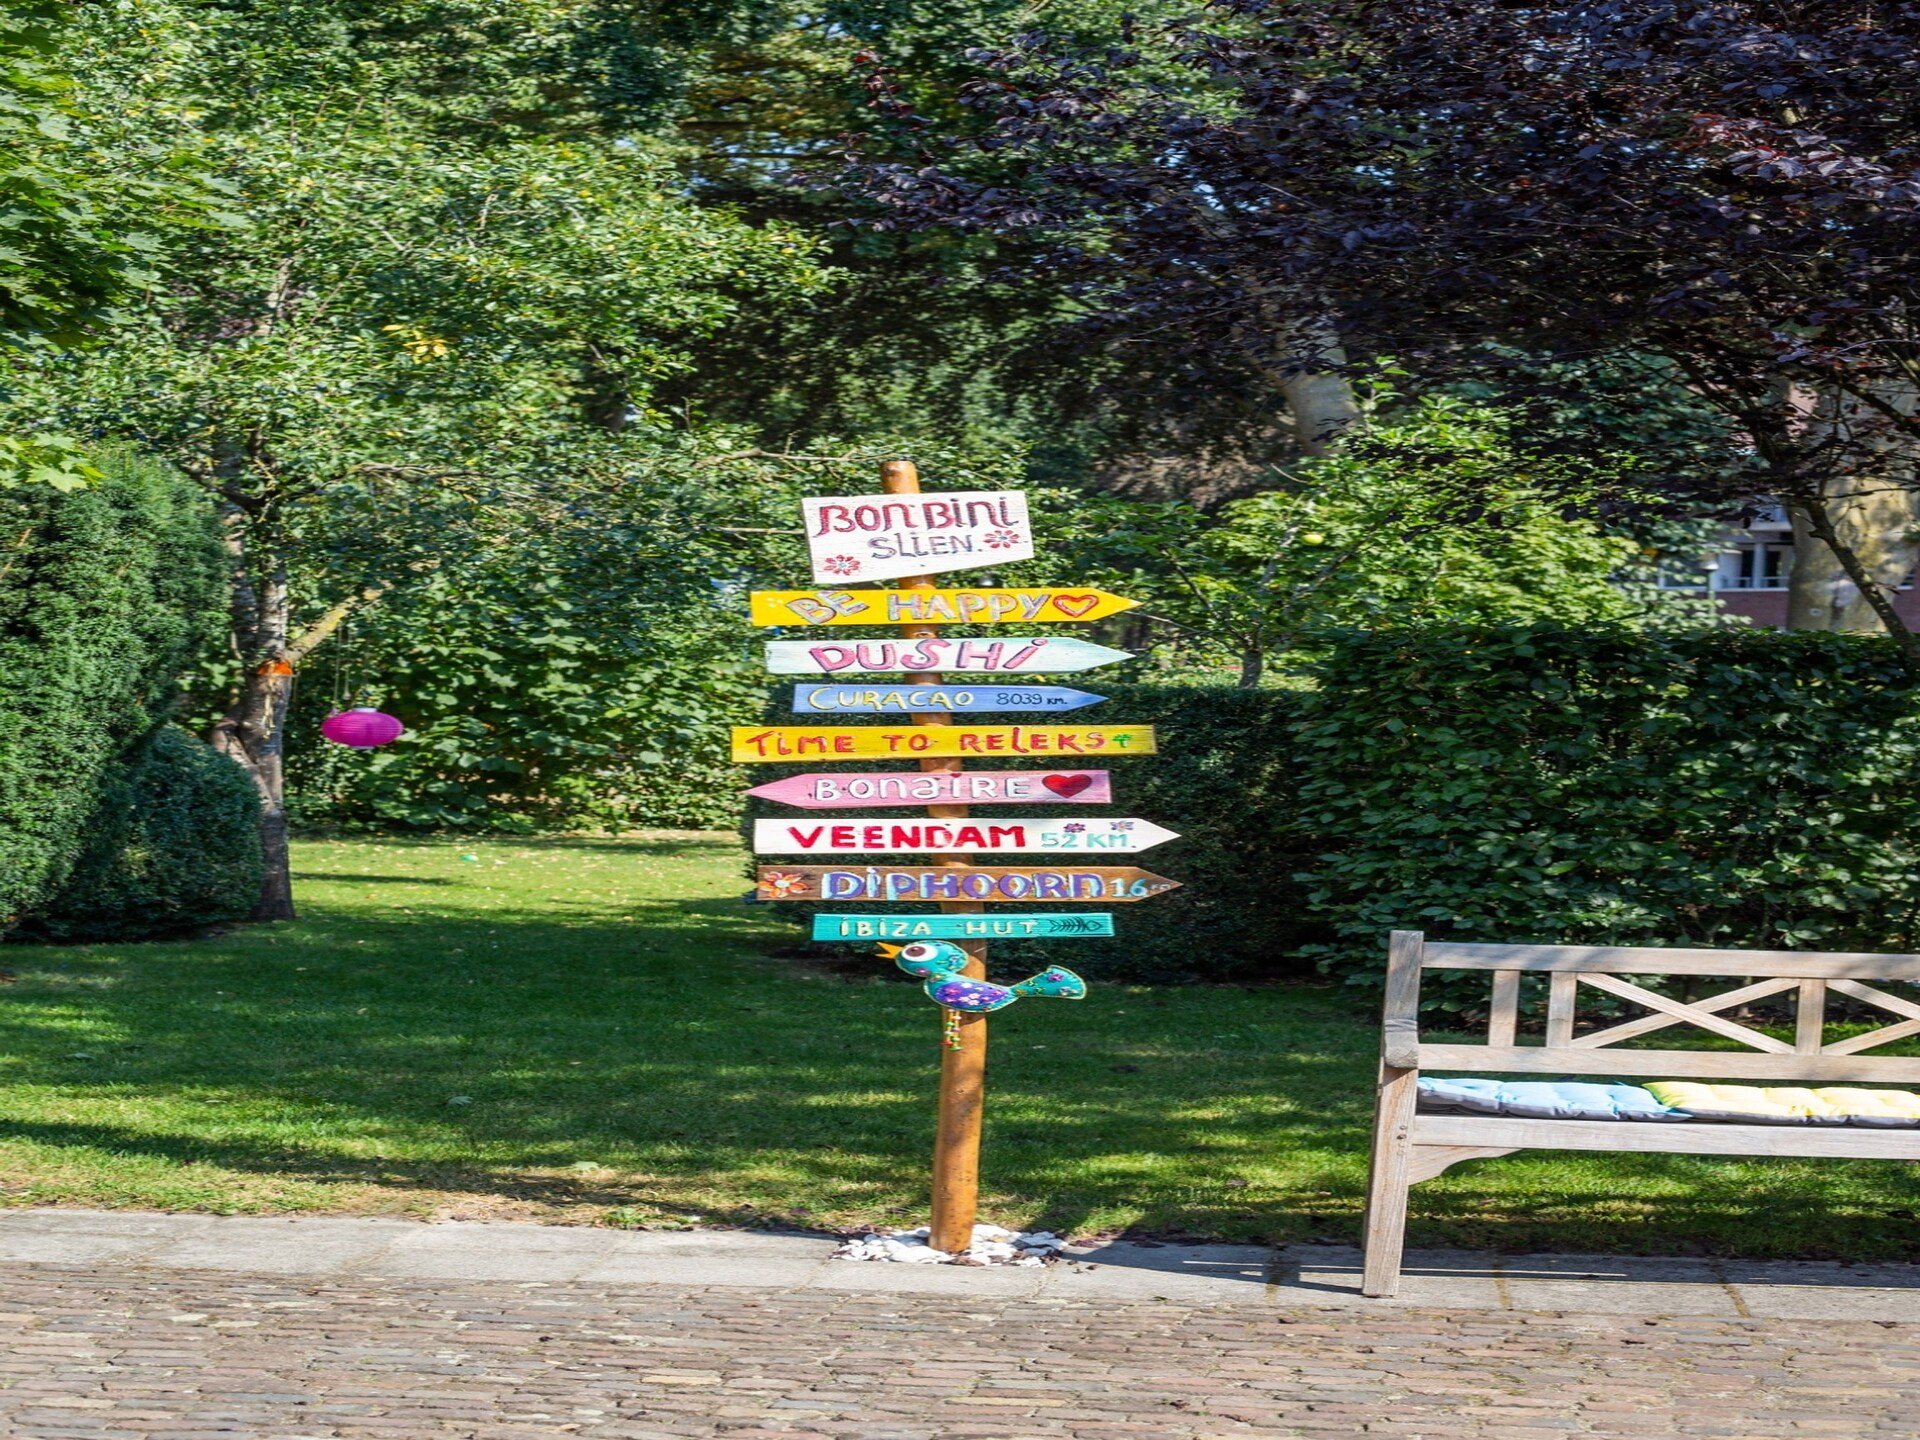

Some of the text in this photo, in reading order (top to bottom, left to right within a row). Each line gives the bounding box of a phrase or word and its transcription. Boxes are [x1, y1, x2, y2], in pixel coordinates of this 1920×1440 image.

[785, 590, 1051, 625] BE HAPPY
[808, 686, 975, 711] CURACAO
[996, 692, 1043, 706] 8039
[882, 733, 930, 751] TO
[786, 825, 1026, 849] VEENDAM
[1041, 832, 1080, 848] 52
[965, 920, 1040, 935] HUT
